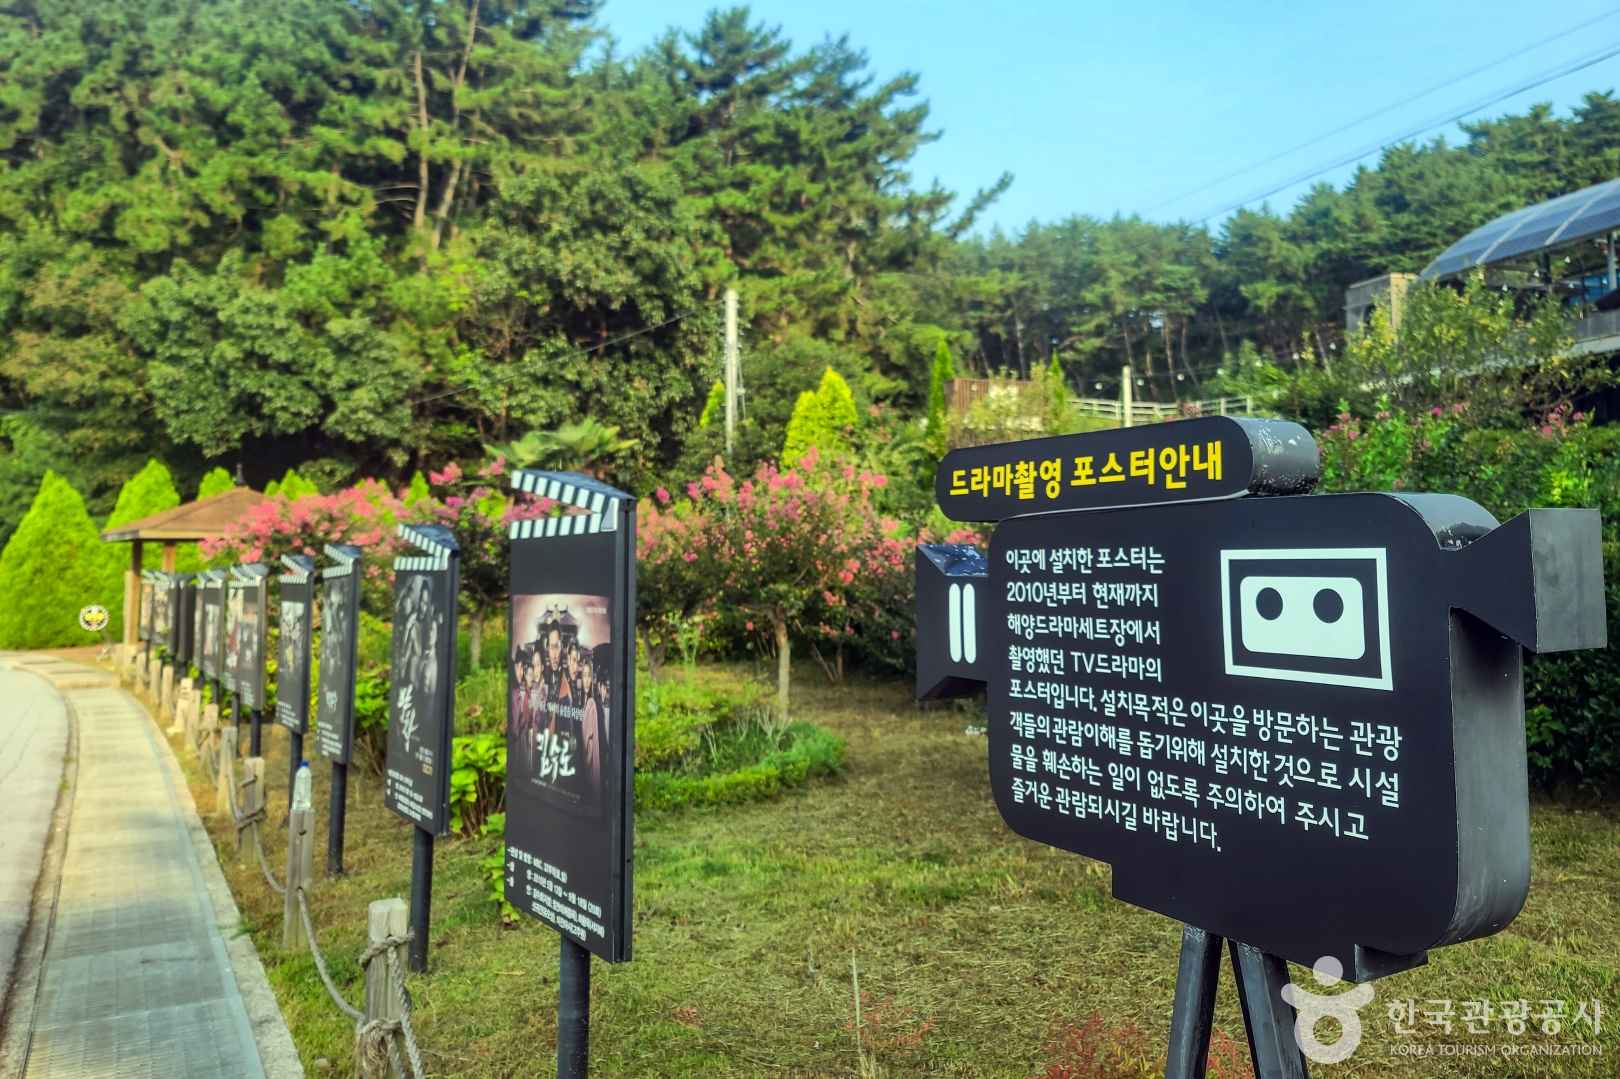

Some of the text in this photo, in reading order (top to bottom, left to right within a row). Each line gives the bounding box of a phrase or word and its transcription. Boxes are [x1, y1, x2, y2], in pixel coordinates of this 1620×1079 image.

[950, 440, 1222, 500] 드라마촬영 포스터안내
[1006, 546, 1165, 574] 이곳에 설치한 포스터는
[1007, 582, 1158, 609] 2010년부터 현재까지
[1007, 613, 1161, 647] 해양드라마세트장에서
[1008, 645, 1162, 682] 촬영했던 TV드라마의
[1010, 711, 1400, 808] 객들의 관람이해를 돕기위해 설치한 것으로 시설
[1190, 701, 1249, 737] 이곳을
[1253, 708, 1343, 751] 방문하는
[1349, 721, 1402, 762] 관광
[1010, 744, 1369, 840] 물을 훼손하는 일이 없도록 주의하여 주시고
[1011, 777, 1221, 852] 즐거운 관람되시길 바랍니다.
